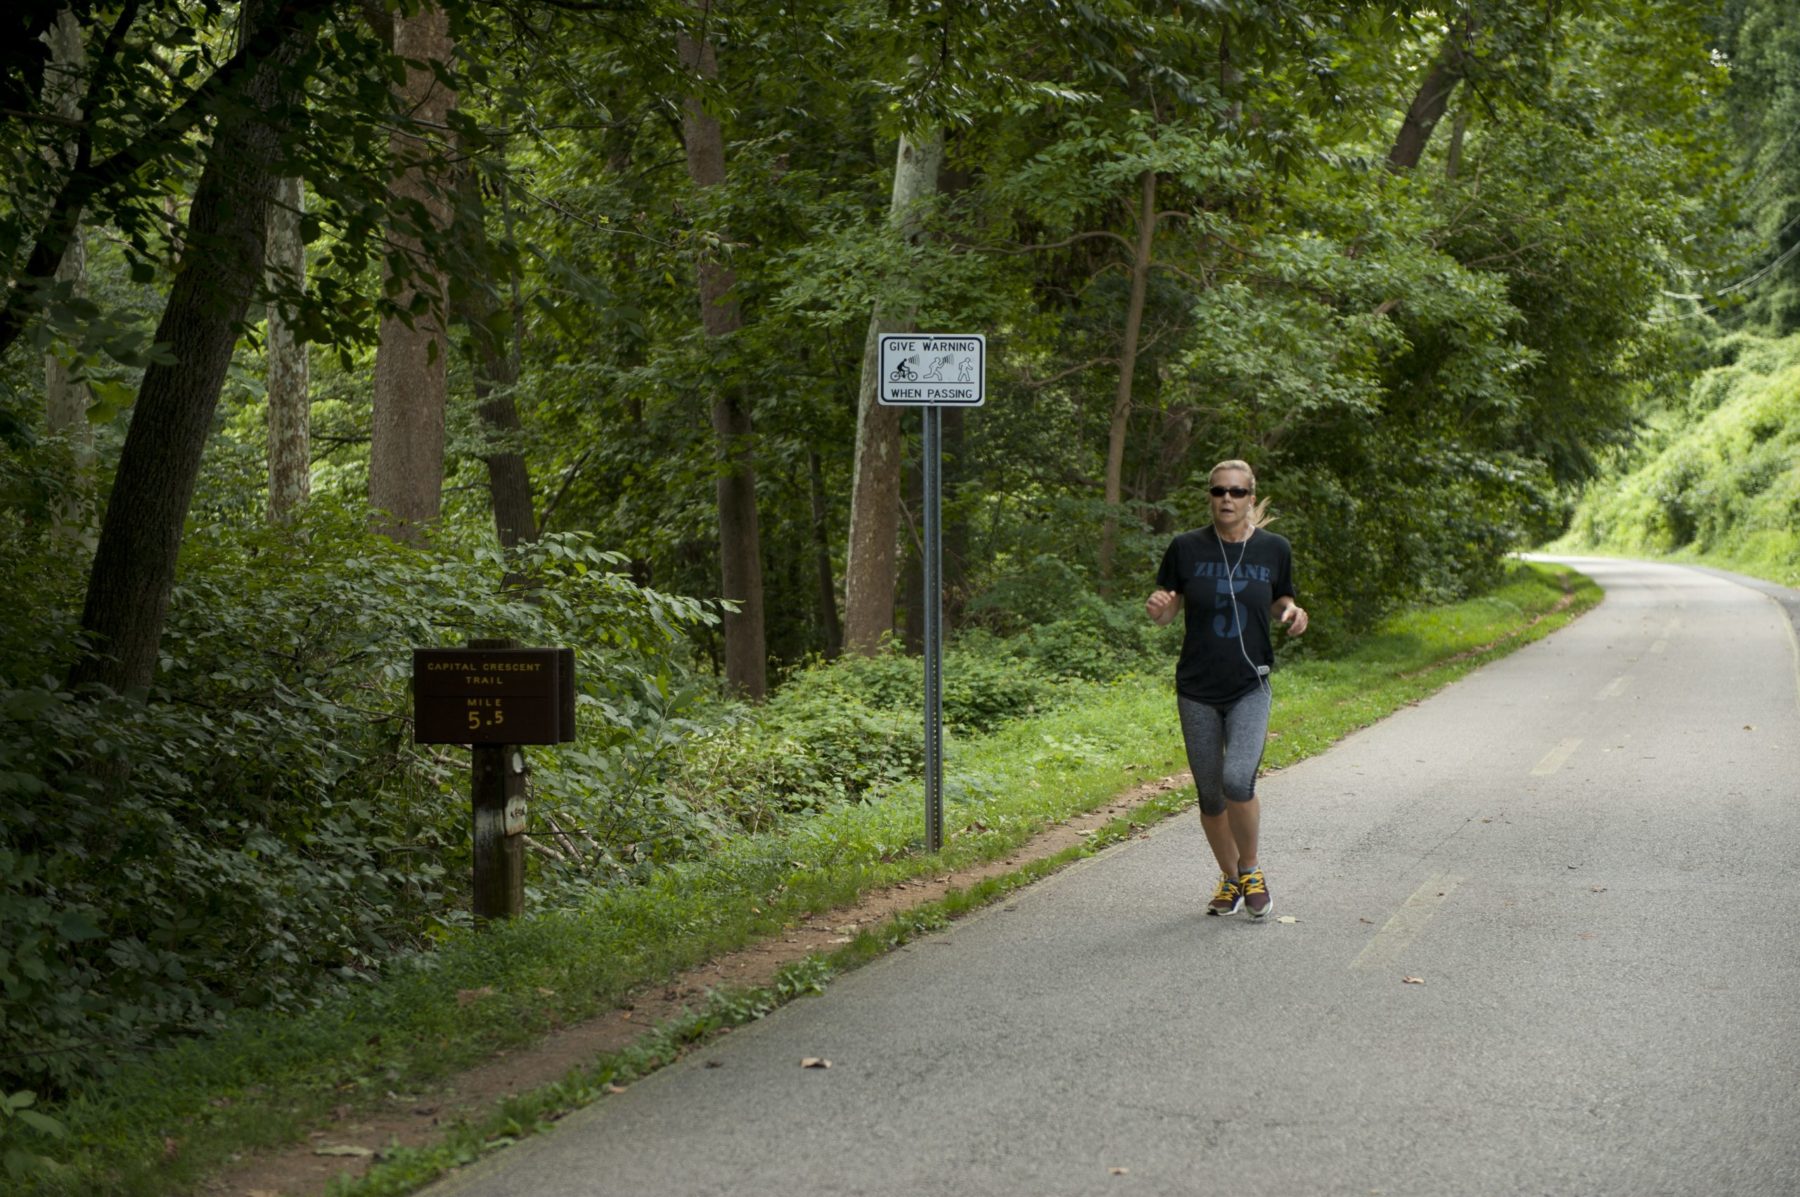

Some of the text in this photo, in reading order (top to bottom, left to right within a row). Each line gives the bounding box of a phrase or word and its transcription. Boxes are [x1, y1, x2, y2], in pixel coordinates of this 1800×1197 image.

[889, 342, 975, 352] GIVE WARNING
[891, 389, 973, 399] WHEN PASSING
[1212, 579, 1249, 639] 5
[427, 662, 541, 672] CAPITAL CRESCENT
[465, 676, 504, 685] TRAIL
[467, 698, 502, 707] MILE
[468, 710, 504, 730] 5.5
